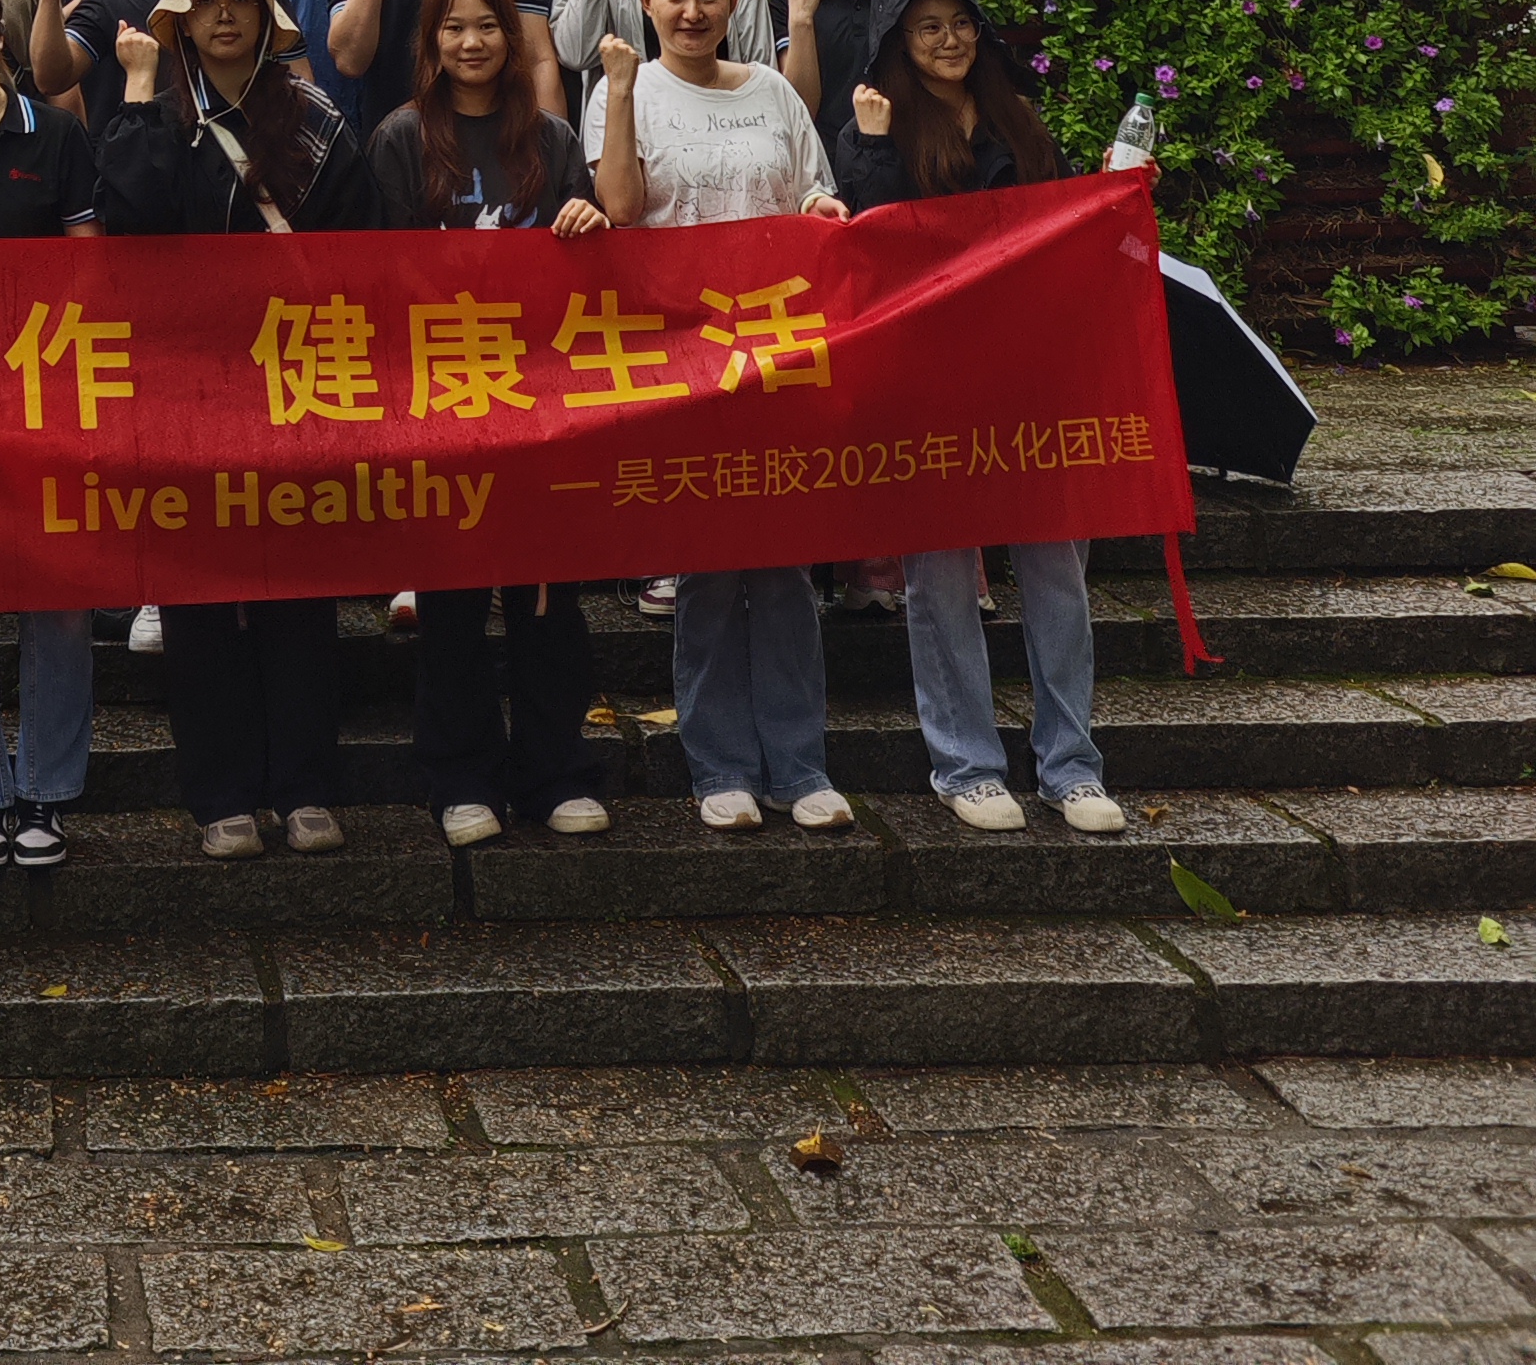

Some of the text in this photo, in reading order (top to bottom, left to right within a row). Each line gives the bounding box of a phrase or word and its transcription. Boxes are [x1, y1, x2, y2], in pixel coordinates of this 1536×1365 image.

[250, 275, 832, 425] 健康生活
[42, 472, 188, 533] Live
[214, 460, 495, 530] Healthy
